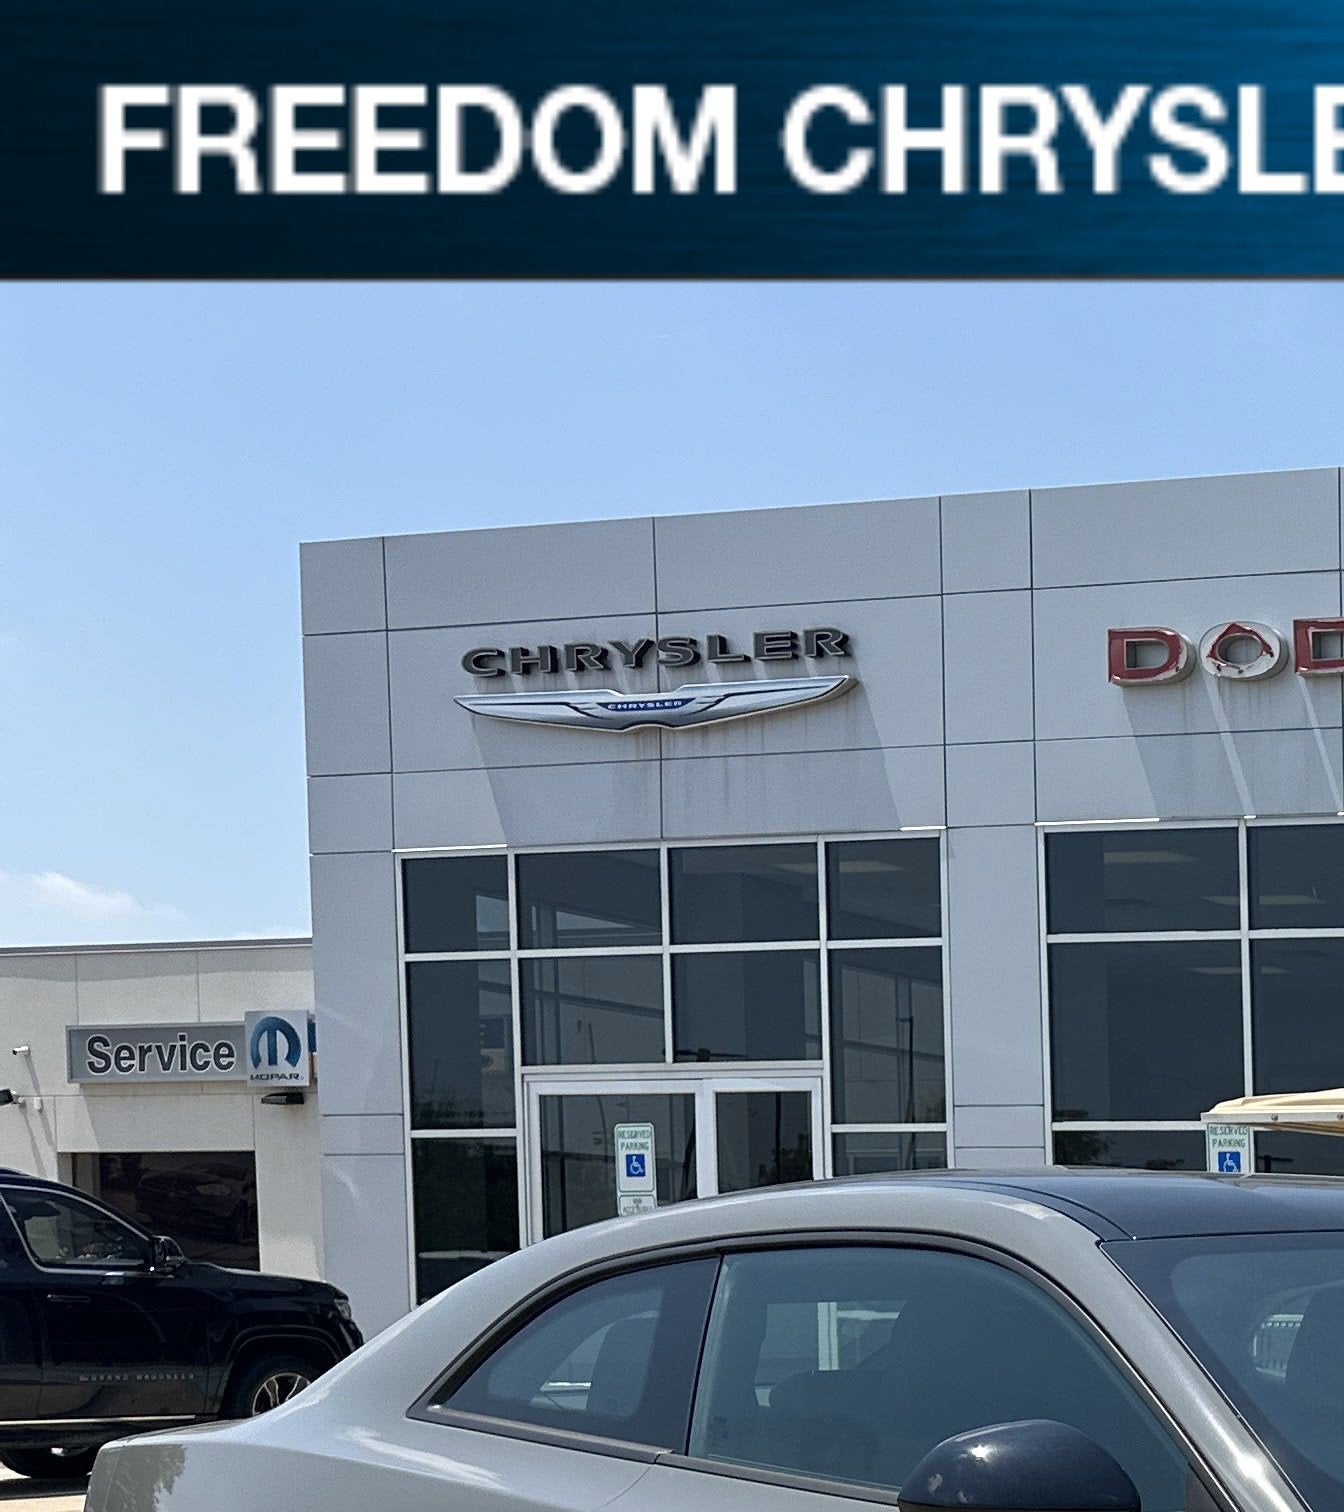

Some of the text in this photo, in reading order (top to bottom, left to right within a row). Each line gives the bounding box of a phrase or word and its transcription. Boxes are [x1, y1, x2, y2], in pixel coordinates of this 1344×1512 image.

[461, 627, 855, 678] CHRYSLER
[607, 700, 682, 710] CHRYSLER
[86, 1032, 236, 1075] Service
[250, 1073, 300, 1081] MOPAR
[620, 1141, 650, 1151] PARKING
[1212, 1138, 1246, 1149] PARKING
